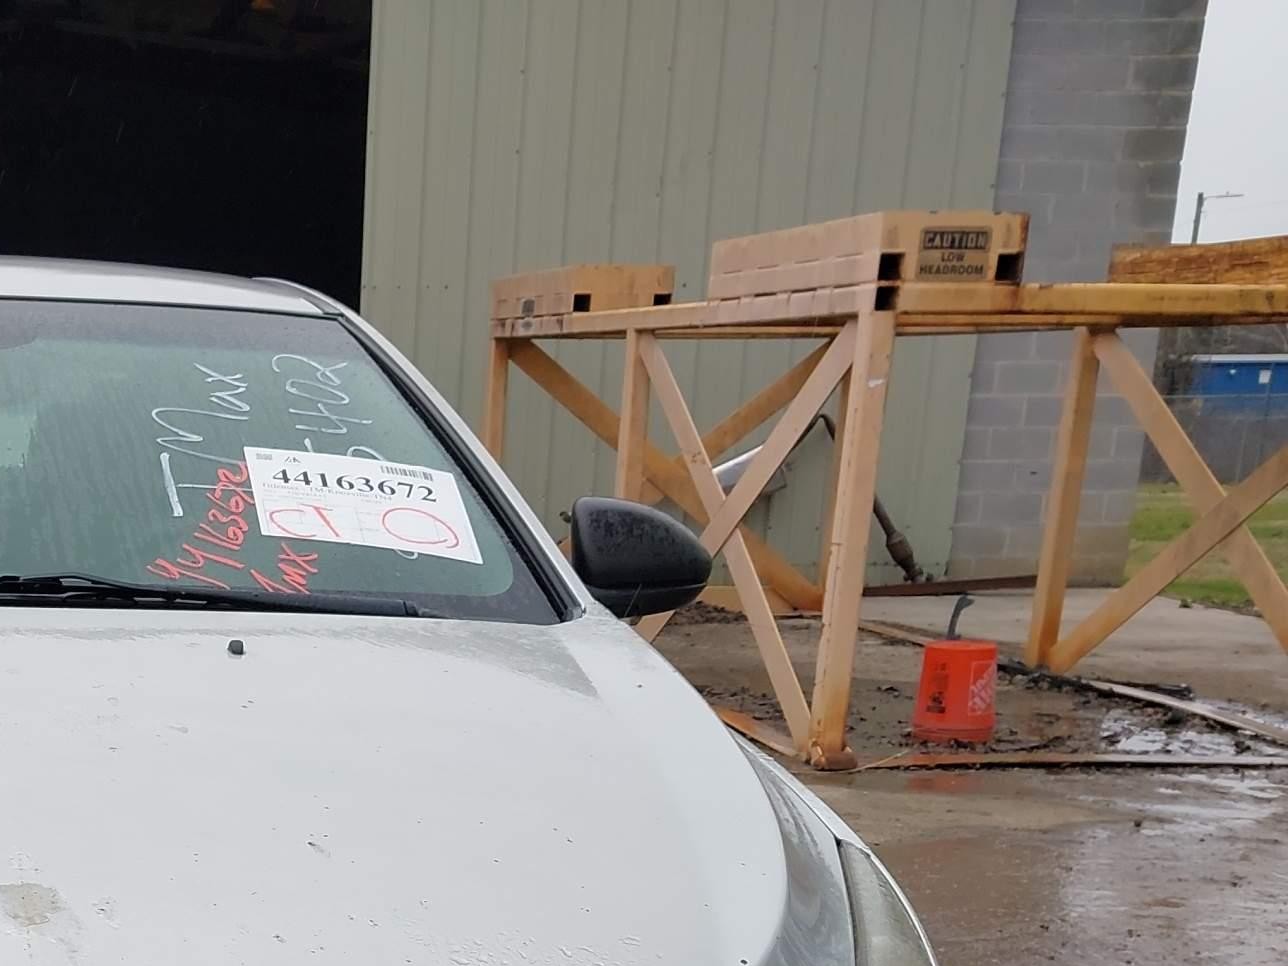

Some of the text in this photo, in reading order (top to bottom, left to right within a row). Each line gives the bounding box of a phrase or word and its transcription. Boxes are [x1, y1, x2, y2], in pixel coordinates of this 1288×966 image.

[924, 231, 987, 249] CAUTION
[941, 252, 966, 263] LOW
[919, 264, 985, 276] HEADROOM
[272, 467, 438, 503] 44163672
